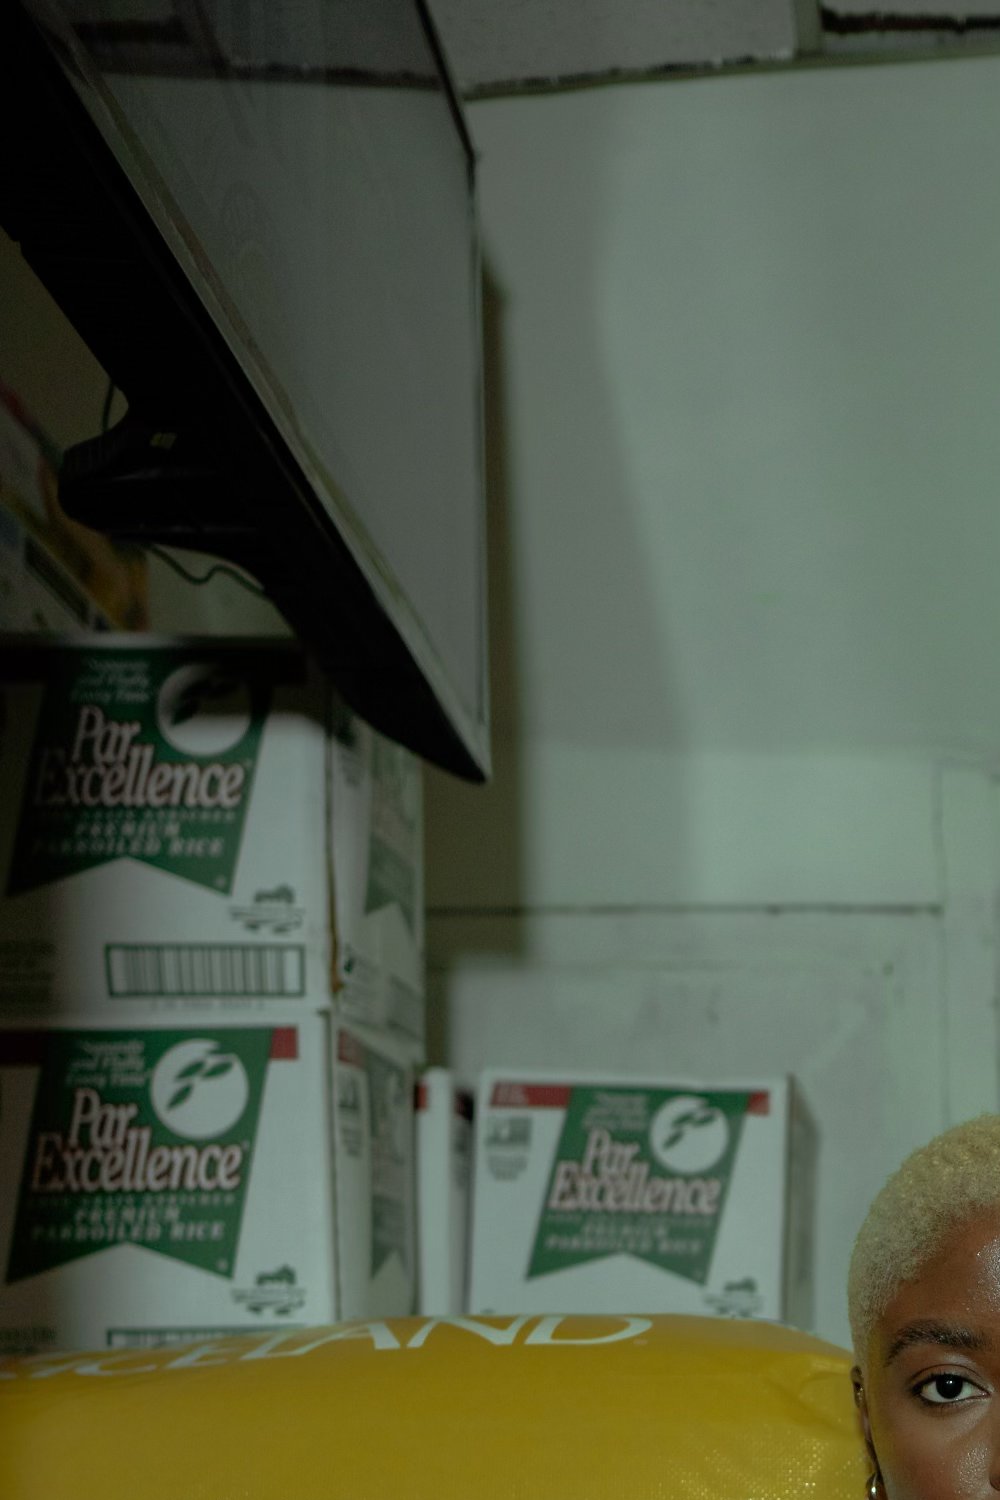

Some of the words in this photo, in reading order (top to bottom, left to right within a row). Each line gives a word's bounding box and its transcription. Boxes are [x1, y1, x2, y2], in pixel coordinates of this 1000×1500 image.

[70, 704, 141, 764] Par
[32, 744, 245, 807] Excellence
[68, 1087, 138, 1148] Par
[31, 1126, 243, 1192] Excellence
[583, 1128, 641, 1176] Par
[548, 1160, 721, 1214] Excellence
[0, 1313, 653, 1380] ICELAND
